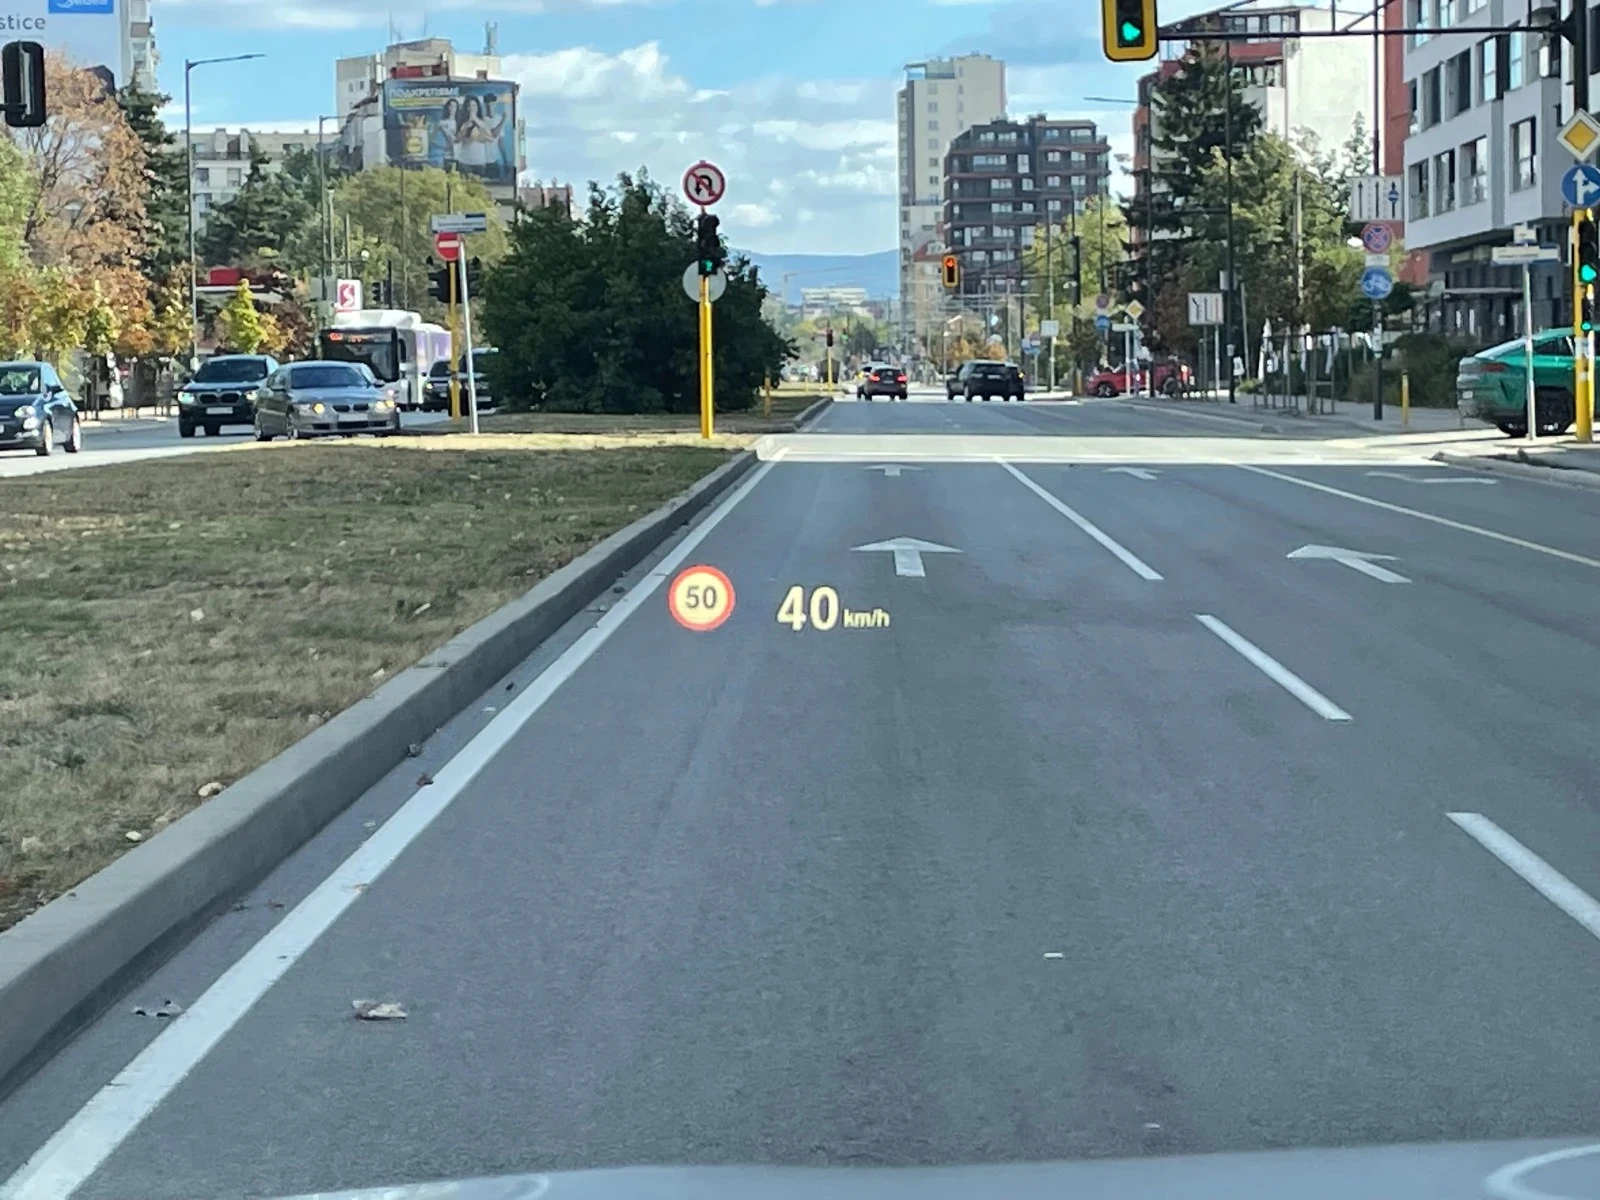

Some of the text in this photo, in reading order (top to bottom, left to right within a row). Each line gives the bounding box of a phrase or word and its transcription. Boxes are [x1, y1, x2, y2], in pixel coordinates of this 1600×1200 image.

[685, 585, 717, 609] 50
[776, 584, 890, 631] 40 km/h
